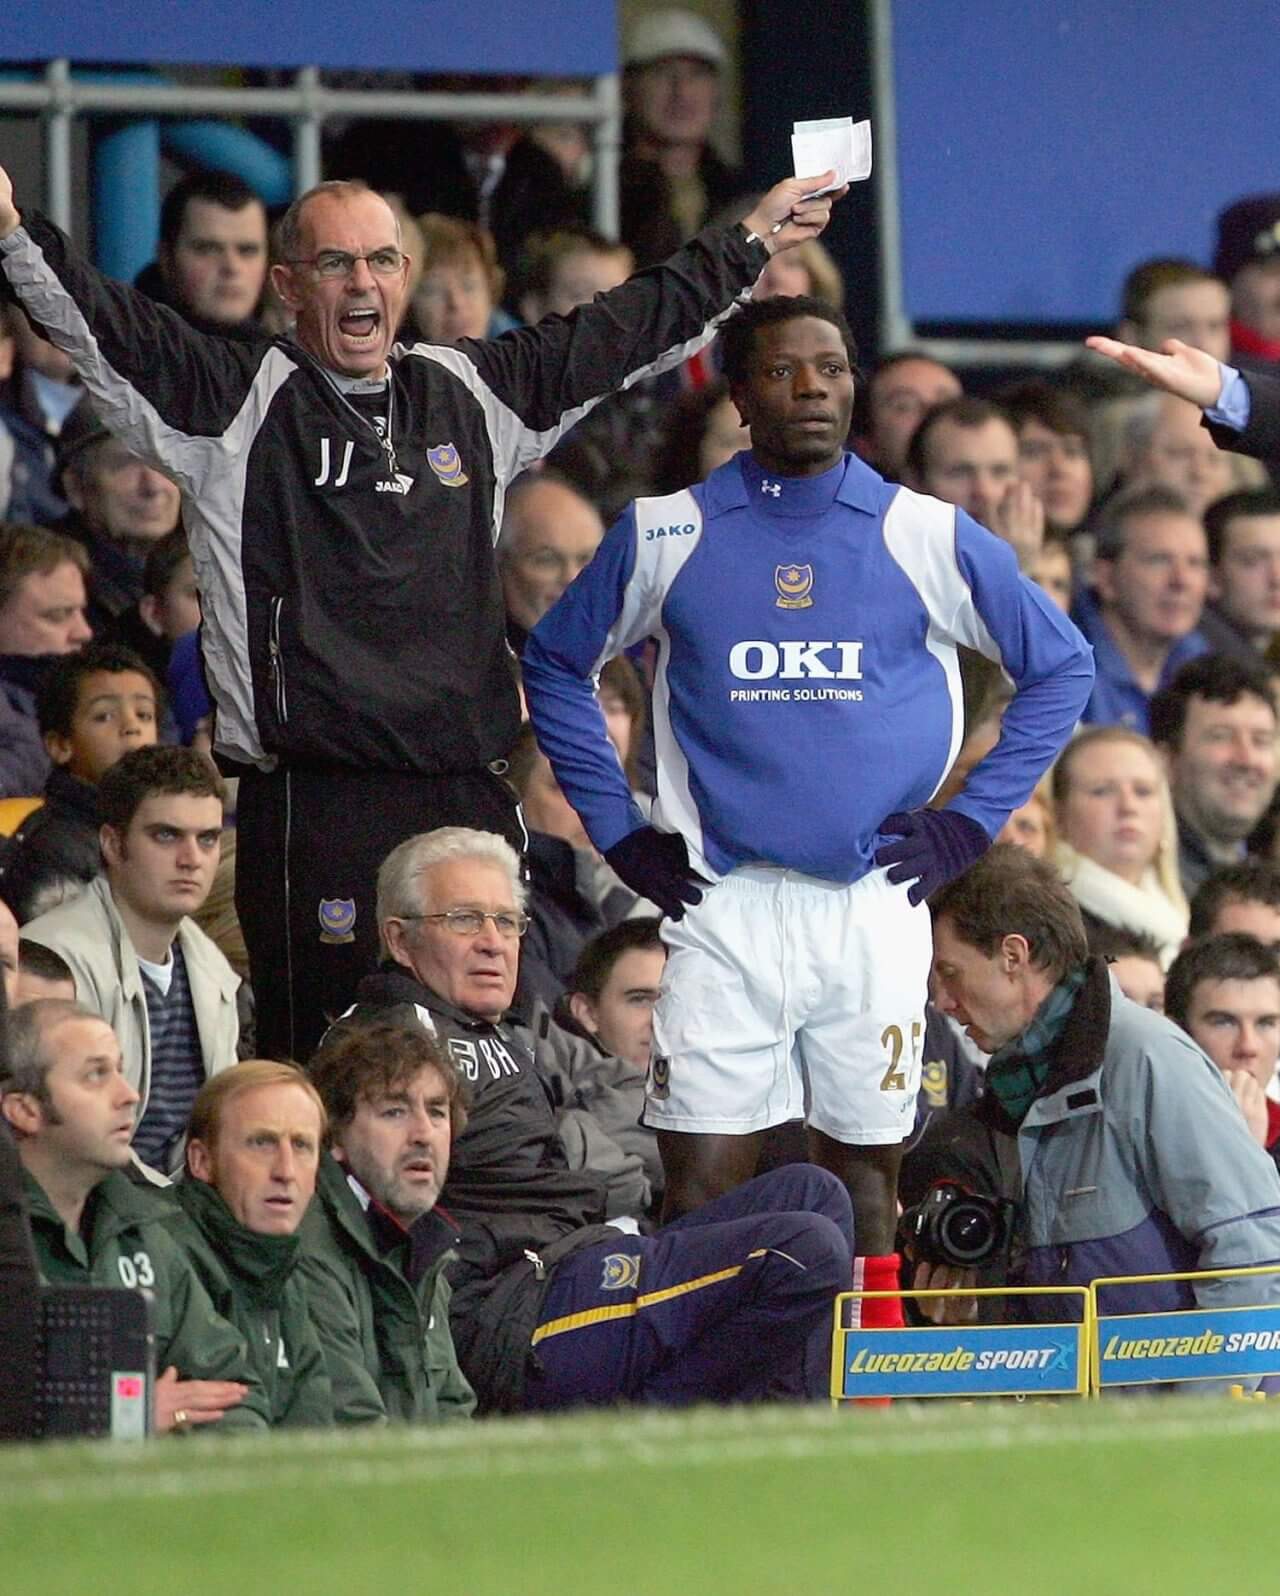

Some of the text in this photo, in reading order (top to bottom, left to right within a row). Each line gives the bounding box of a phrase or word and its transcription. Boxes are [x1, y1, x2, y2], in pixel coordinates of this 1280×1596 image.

[315, 437, 354, 487] JJ
[645, 523, 696, 541] JAKO
[729, 640, 864, 680] OKI
[730, 688, 863, 701] PRINTING SOLUTIONS
[479, 1038, 520, 1080] BH
[117, 1251, 155, 1289] 03
[849, 1346, 1056, 1374] Lucozade SPORT
[1103, 1328, 1225, 1361] Lucozade
